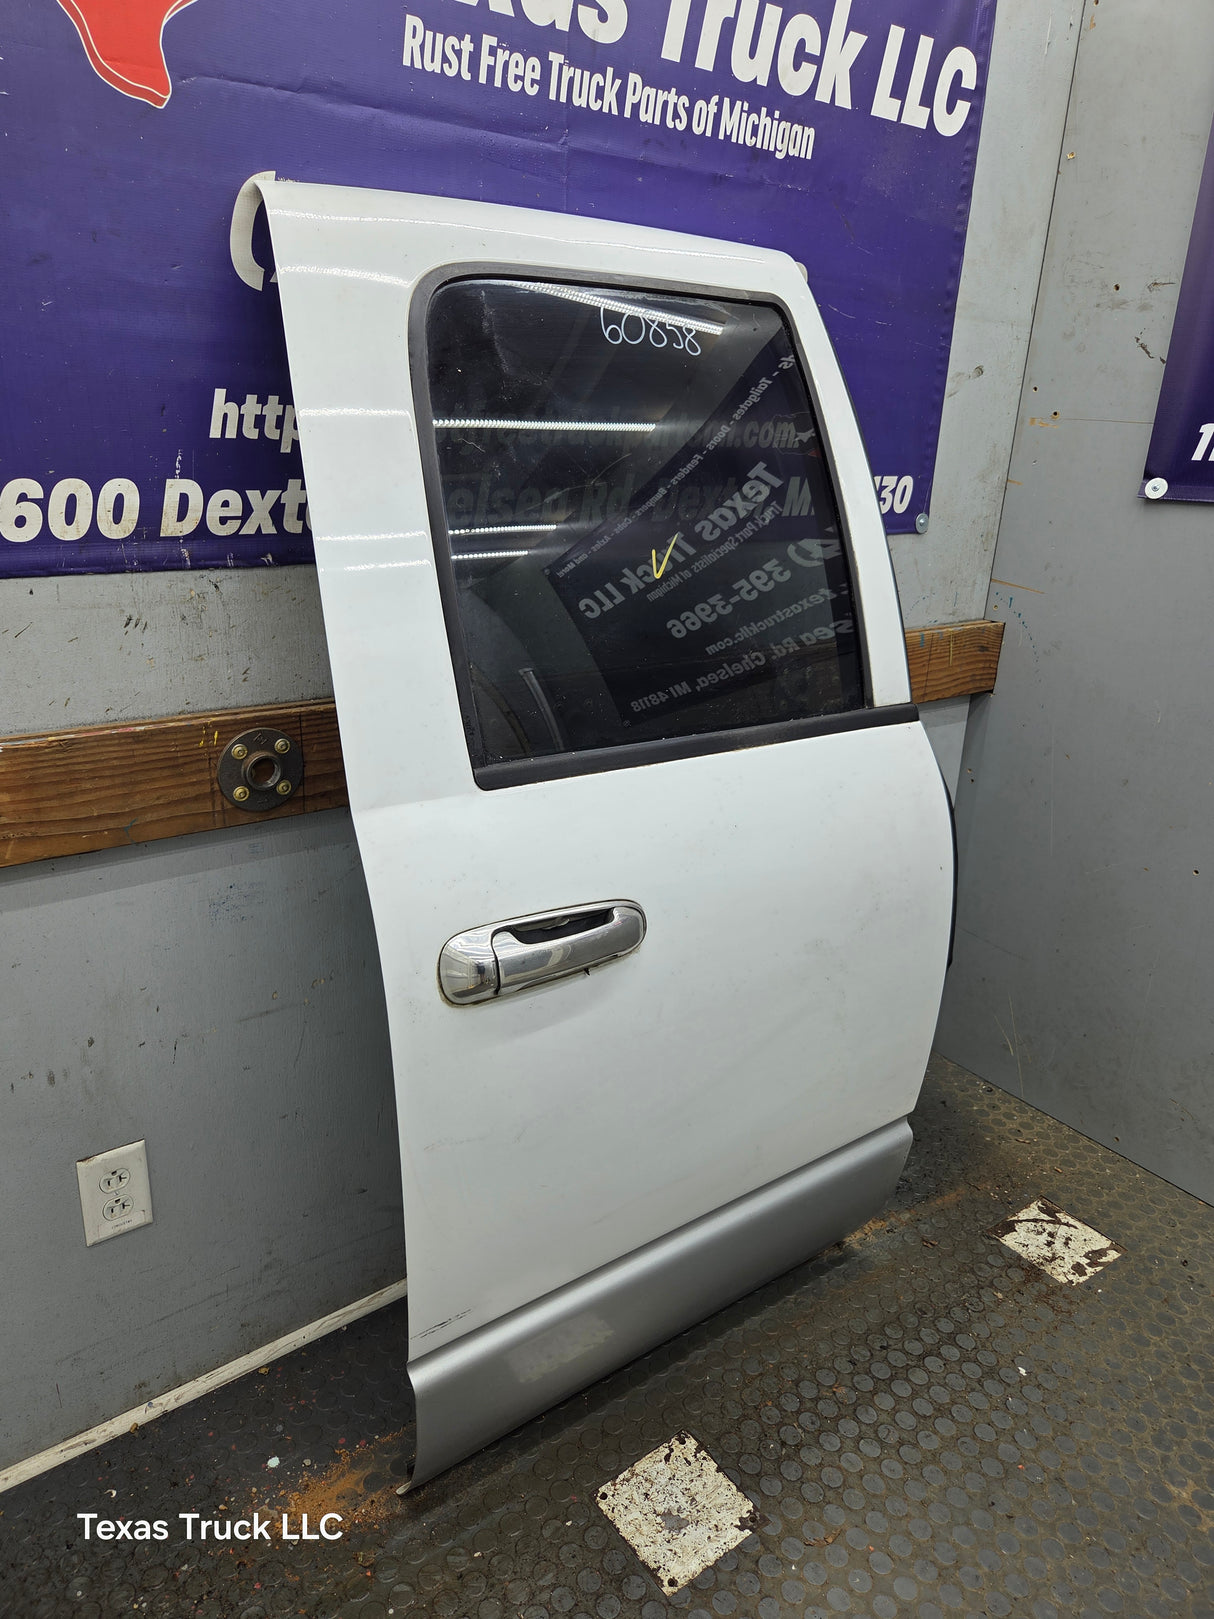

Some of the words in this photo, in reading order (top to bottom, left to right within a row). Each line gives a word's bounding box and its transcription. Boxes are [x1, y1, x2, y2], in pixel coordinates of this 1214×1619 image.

[402, 13, 474, 81] Rust
[478, 33, 541, 96] Free
[548, 51, 623, 116] Truck
[623, 71, 690, 131] Parts
[692, 94, 720, 137] of
[718, 97, 815, 160] Michigan
[870, 24, 977, 137] LLC
[160, 478, 313, 537] Dext
